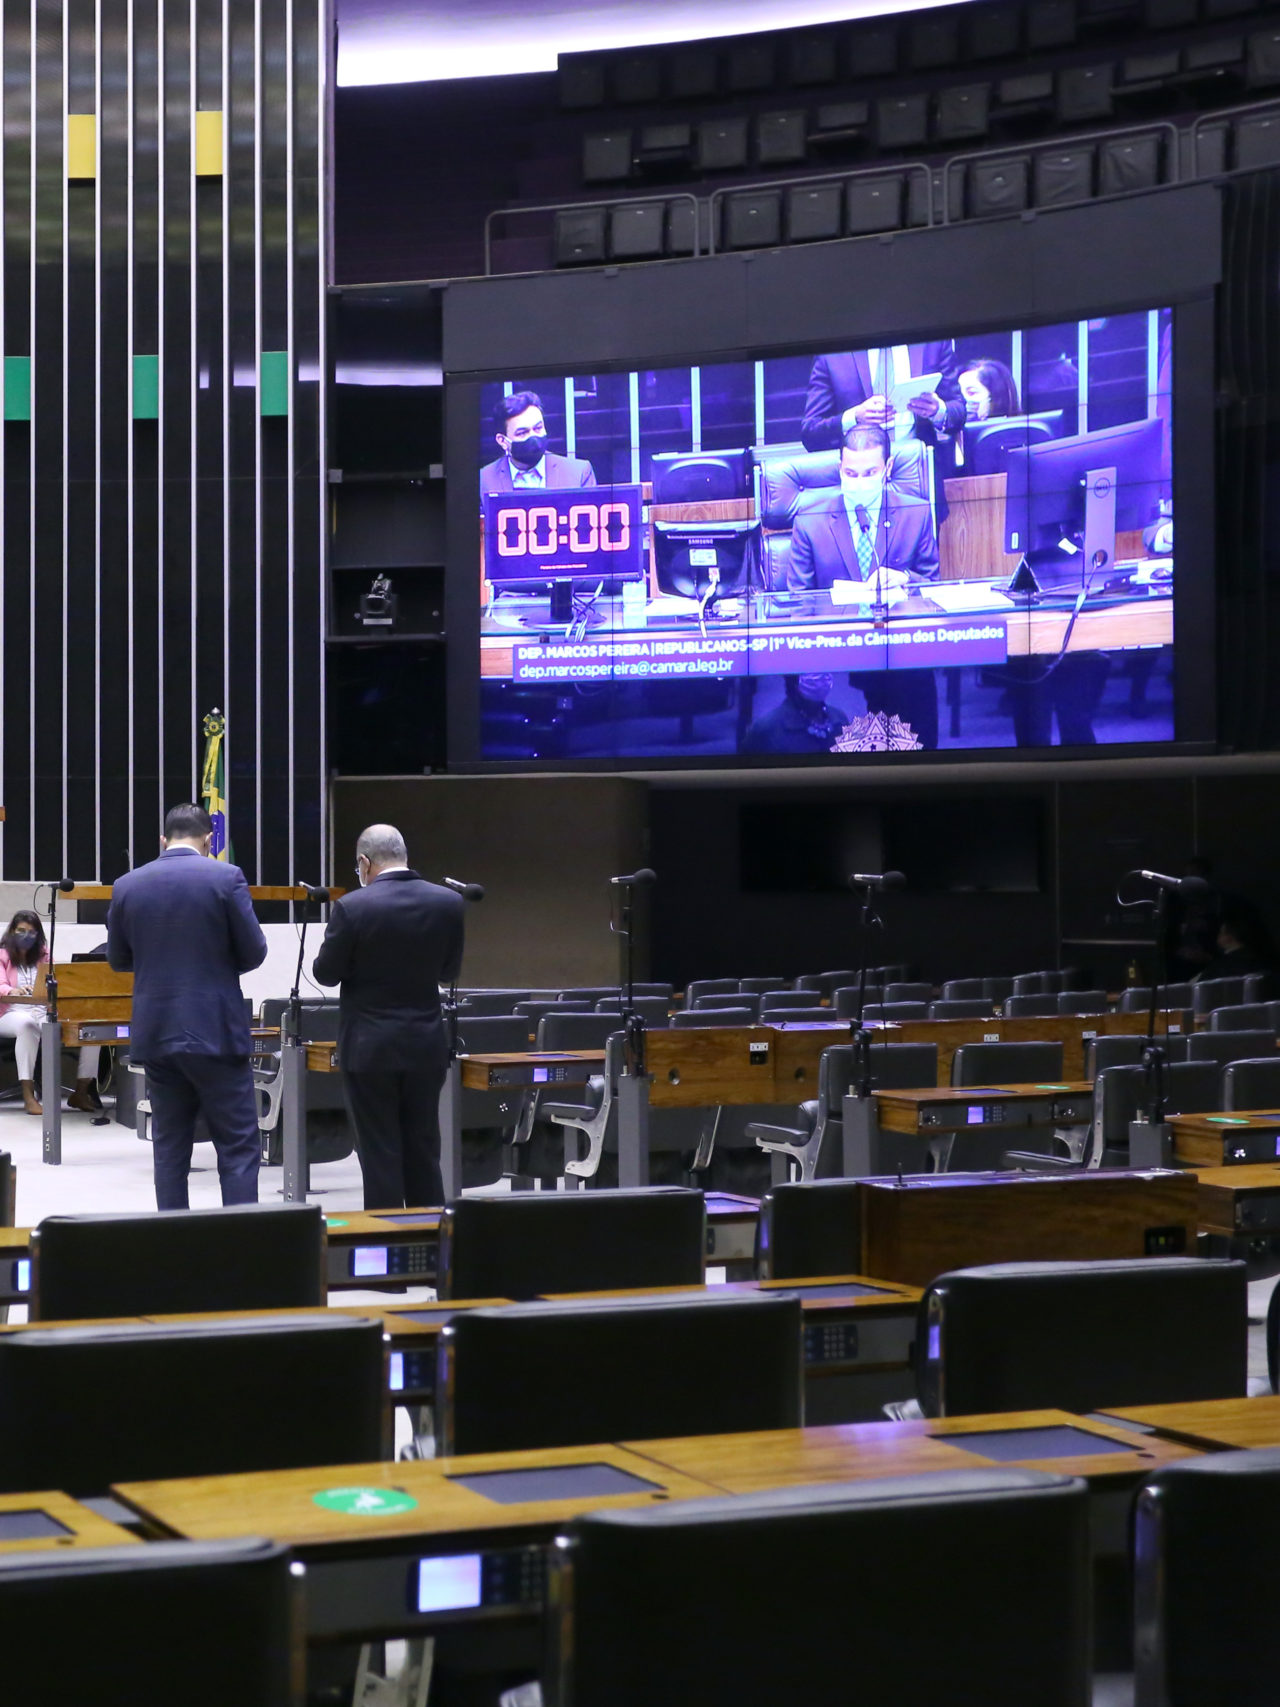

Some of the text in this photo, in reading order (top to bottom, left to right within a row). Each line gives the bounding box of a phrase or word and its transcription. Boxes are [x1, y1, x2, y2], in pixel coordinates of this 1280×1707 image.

[498, 503, 630, 557] 00:00
[518, 646, 546, 660] DEP.
[547, 644, 597, 659] MARCOS
[599, 642, 650, 657] PEREIRA
[787, 634, 846, 649] Vice-Pres.
[846, 633, 863, 646] da
[864, 630, 912, 645] Câmara
[913, 628, 935, 643] dos
[937, 626, 1004, 643] Deputados
